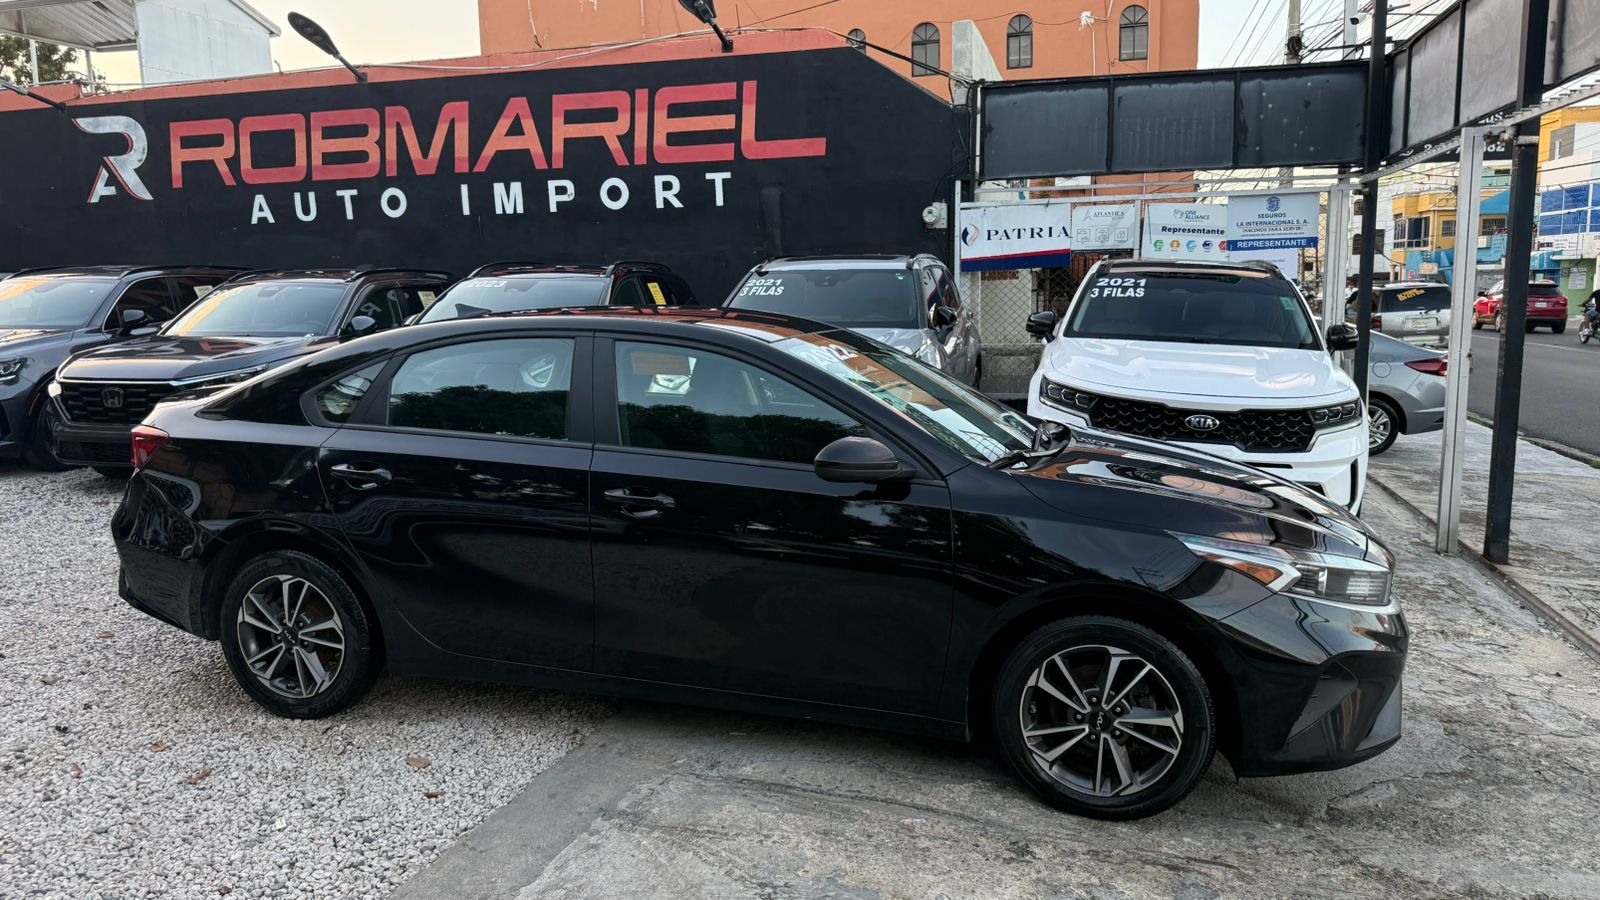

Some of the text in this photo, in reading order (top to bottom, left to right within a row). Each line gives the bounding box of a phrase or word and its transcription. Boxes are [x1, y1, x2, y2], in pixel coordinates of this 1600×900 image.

[169, 80, 826, 189] ROBMARIEL
[250, 171, 732, 225] AUTO IMPORT
[1245, 219, 1295, 227] INTERNACIONAL
[986, 226, 1069, 241] PATRIA
[1161, 226, 1225, 235] Representante
[1237, 239, 1307, 248] REPRESENTANTE
[746, 279, 783, 287] 2021
[1096, 278, 1147, 287] 2021
[749, 287, 784, 296] FILAS
[1090, 287, 1145, 298] 3 FILAS
